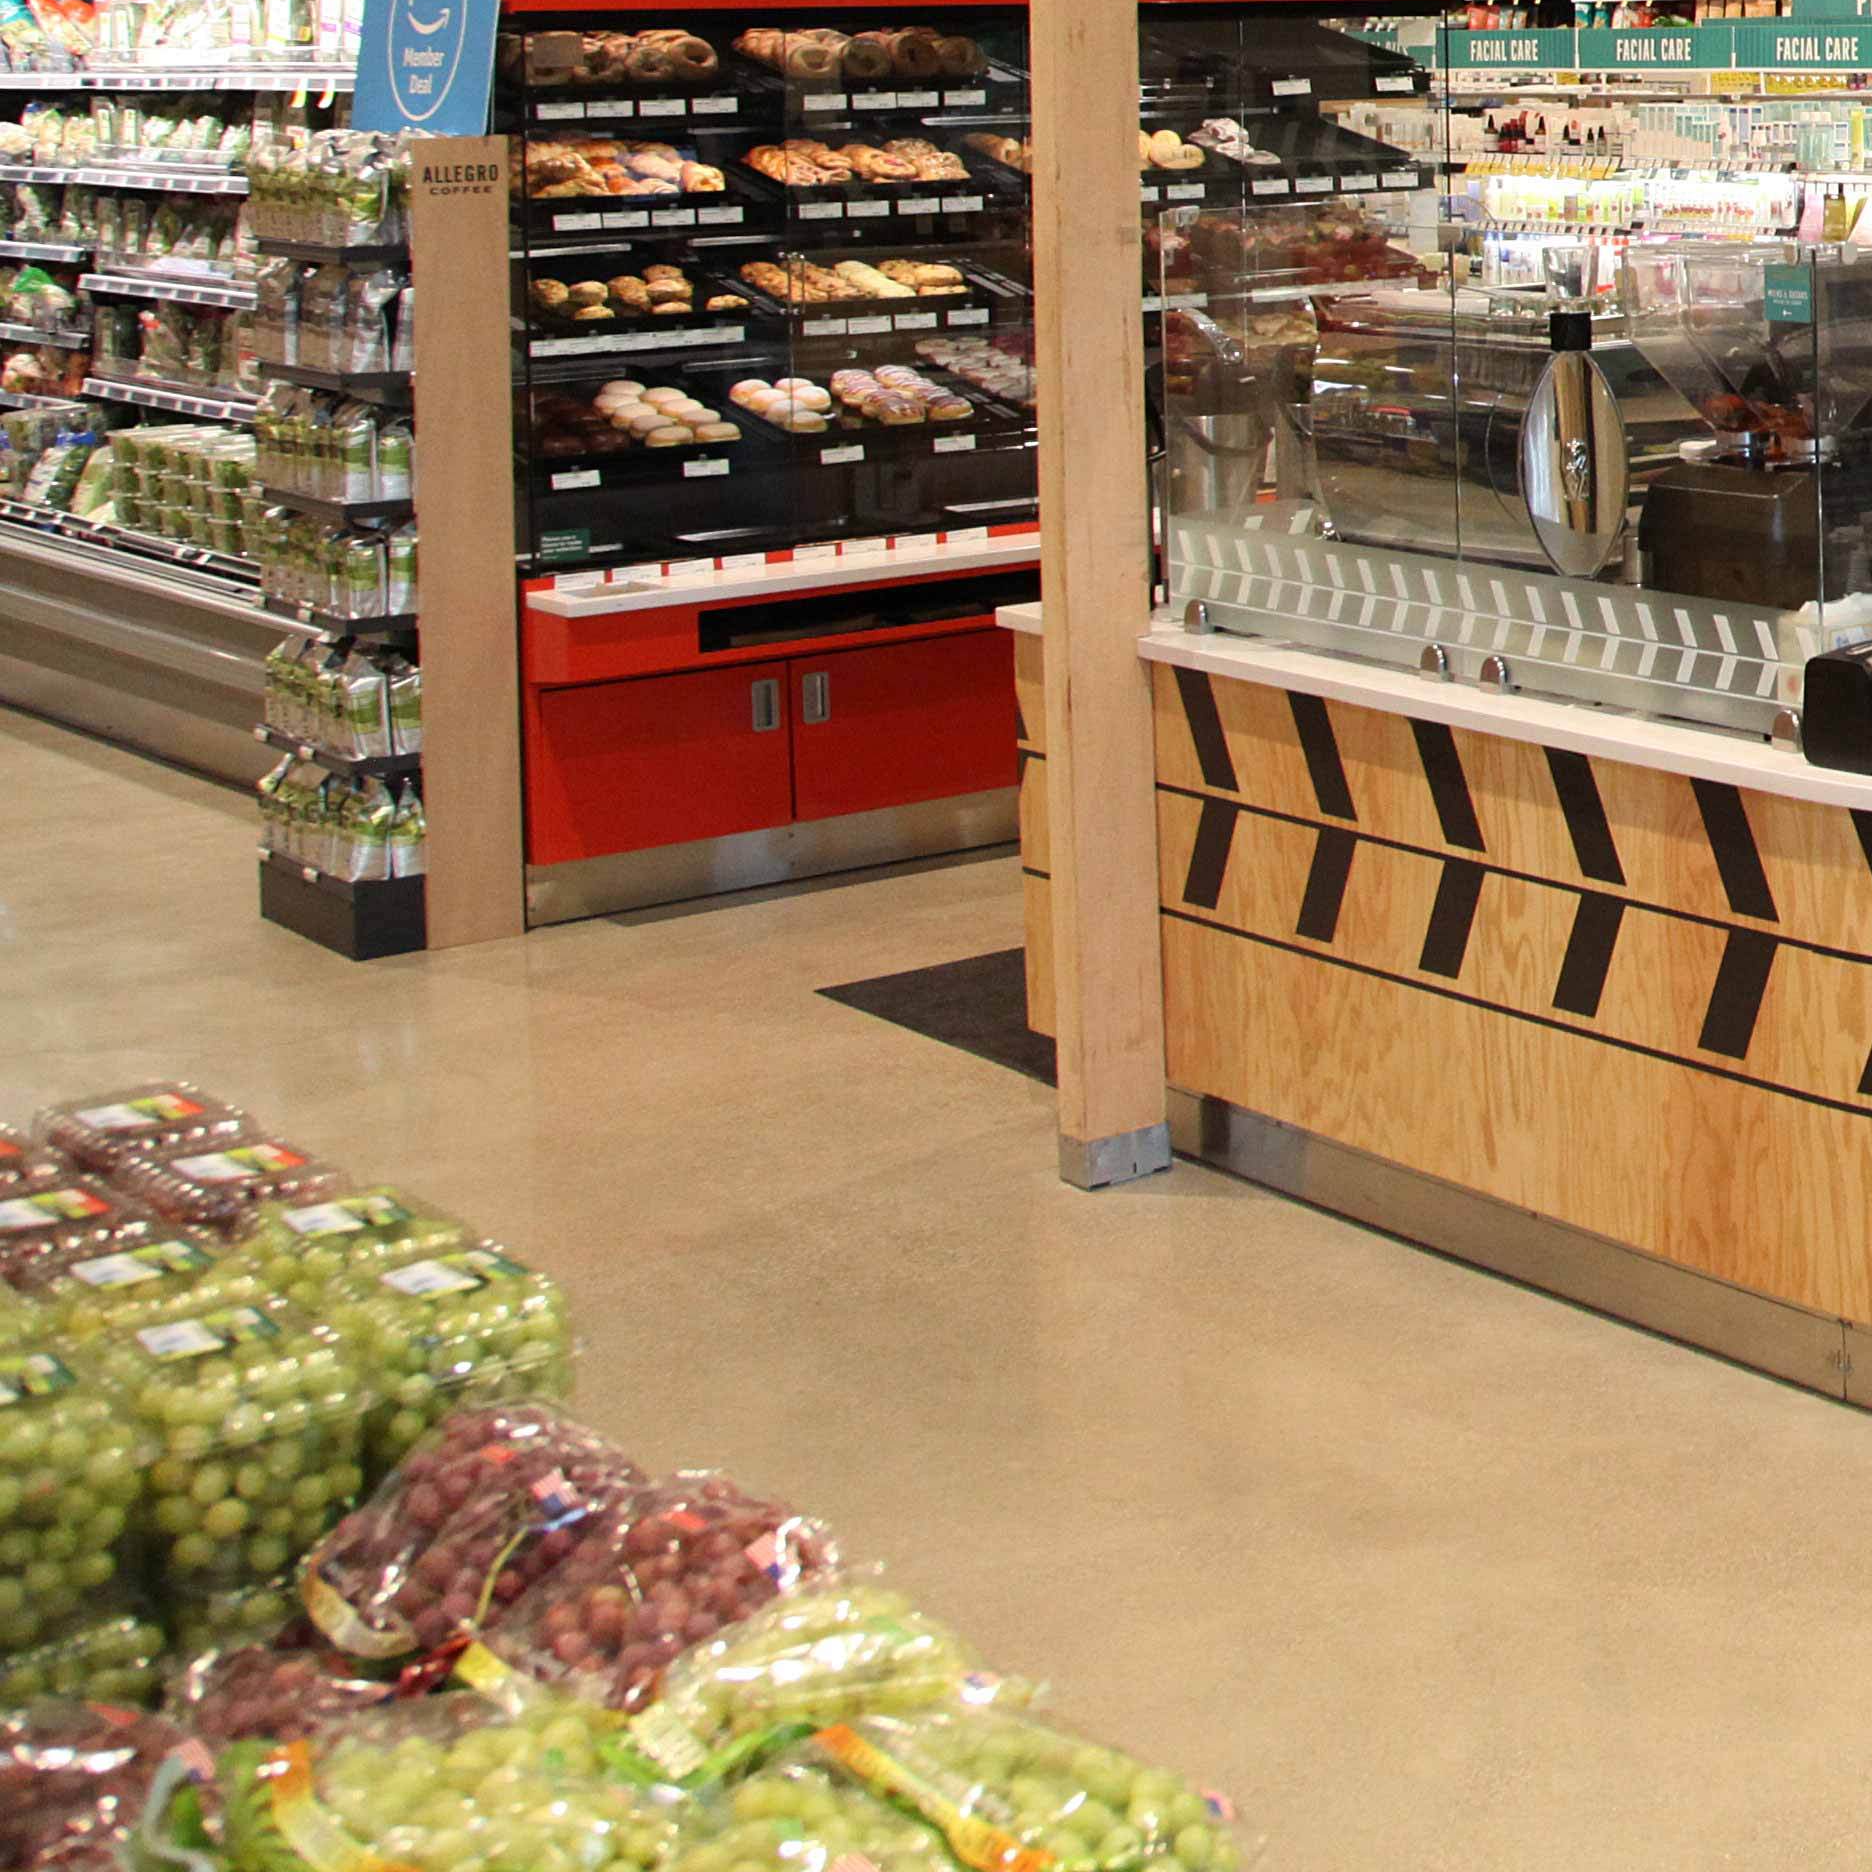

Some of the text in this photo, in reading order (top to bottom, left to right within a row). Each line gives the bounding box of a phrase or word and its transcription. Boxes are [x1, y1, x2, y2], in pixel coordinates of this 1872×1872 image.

[403, 47, 445, 68] Member
[1470, 39, 1539, 62] FACIAL CARE
[1616, 38, 1692, 62] FACIAL CARE
[1776, 37, 1859, 62] FACIAL CARE
[409, 73, 432, 95] Deal
[423, 164, 499, 184] ALLEGRO
[430, 185, 492, 195] COFFEE
